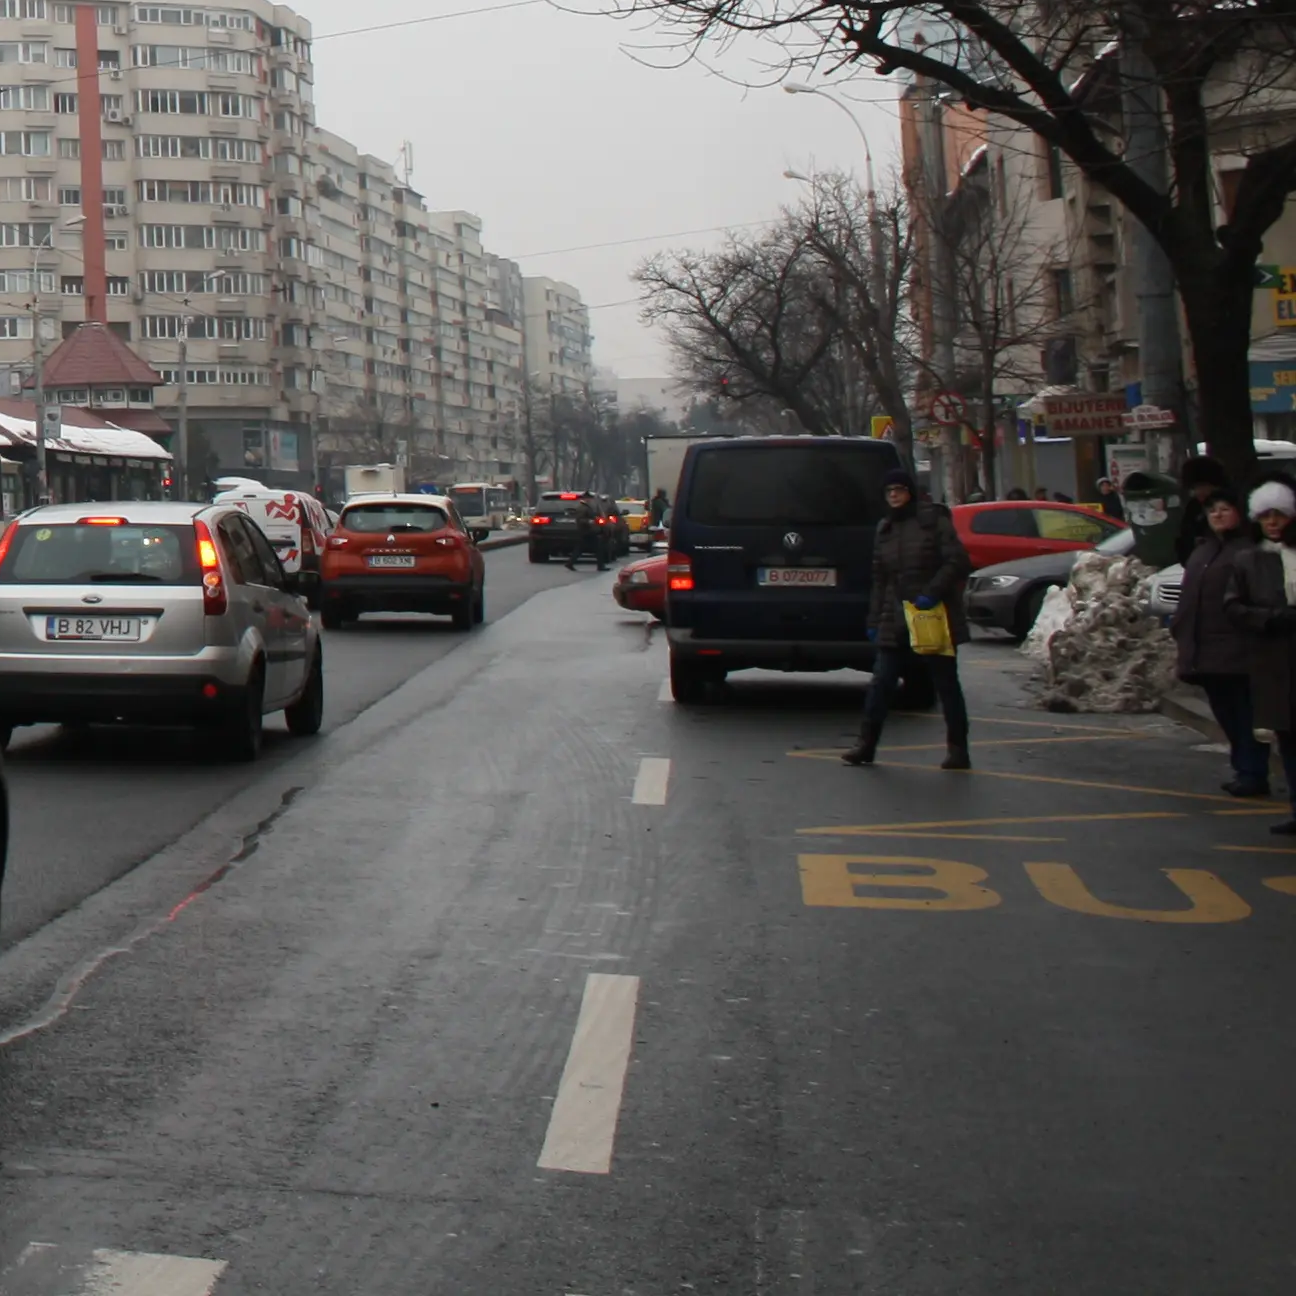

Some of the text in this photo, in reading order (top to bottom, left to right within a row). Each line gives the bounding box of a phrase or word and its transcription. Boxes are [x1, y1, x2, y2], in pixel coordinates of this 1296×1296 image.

[769, 570, 829, 582] B 072077
[58, 619, 131, 635] B 82 VHJ
[797, 853, 1296, 924] BU
